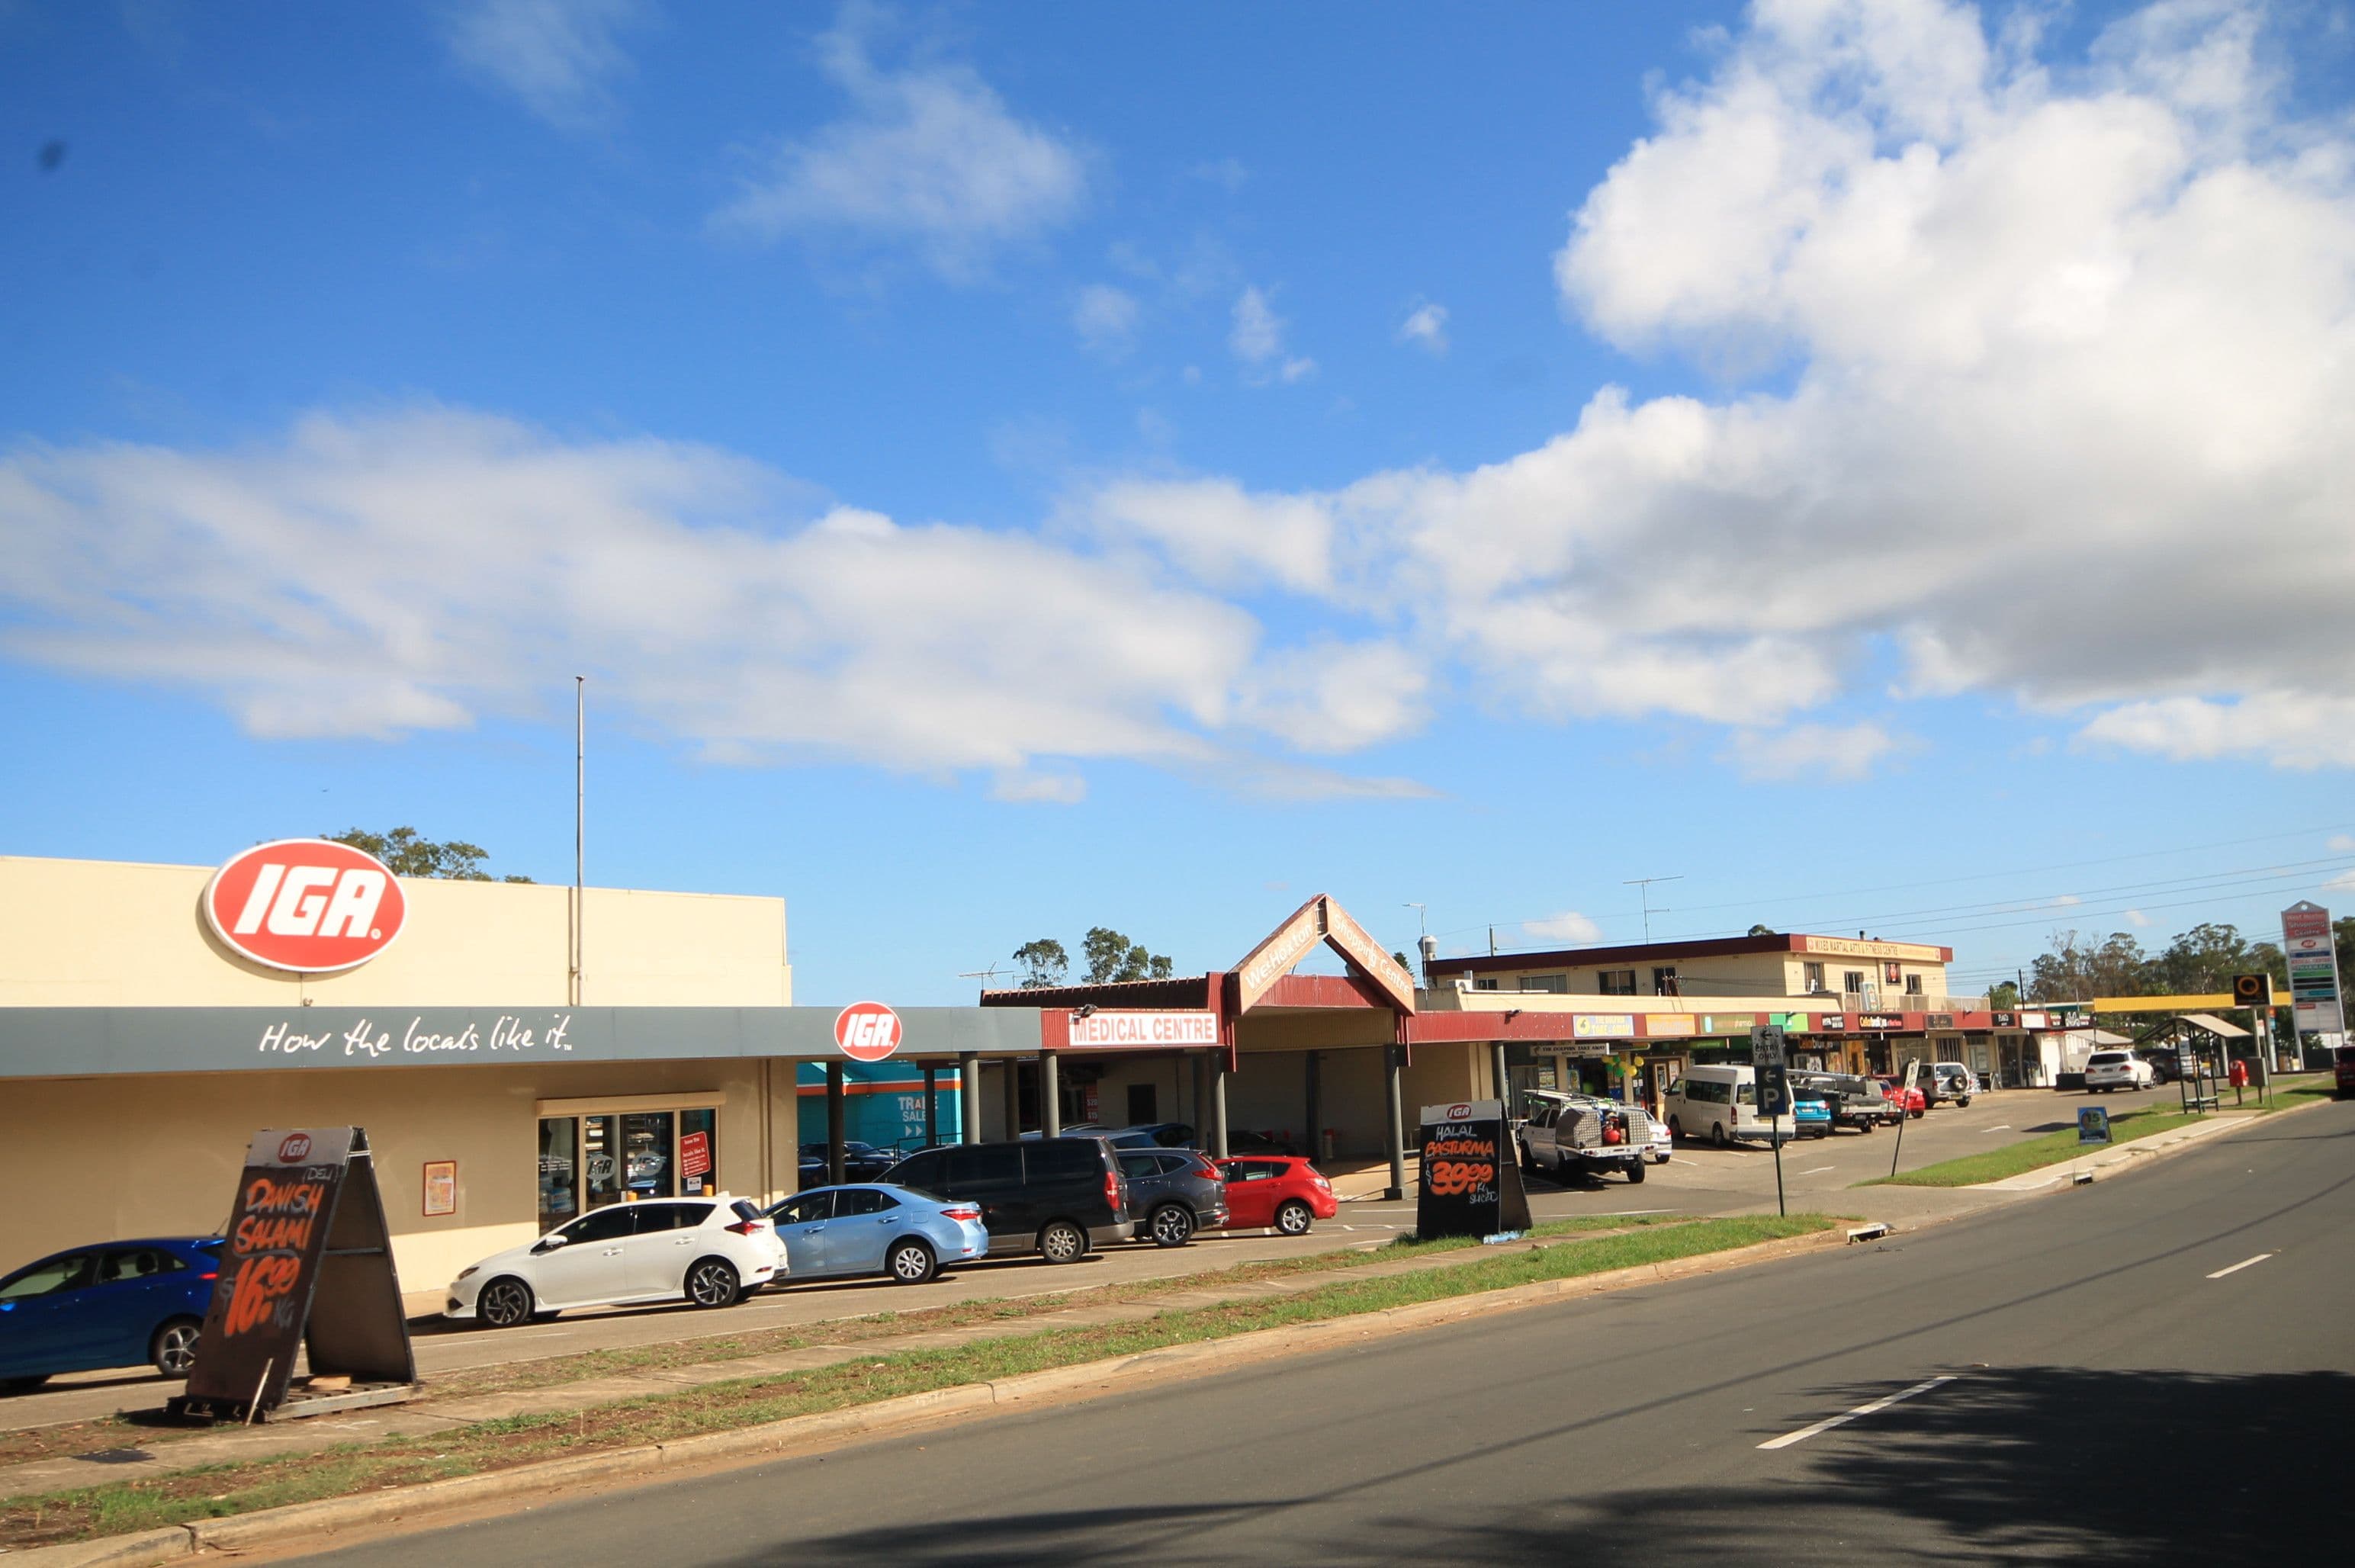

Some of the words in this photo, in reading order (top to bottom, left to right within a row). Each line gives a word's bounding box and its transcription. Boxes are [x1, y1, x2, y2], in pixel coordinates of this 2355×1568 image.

[1333, 914, 1377, 969] Shopping
[1380, 959, 1409, 996] Centre
[259, 1021, 331, 1053] How
[344, 1017, 391, 1057] the
[490, 1015, 534, 1050] like
[842, 1013, 895, 1047] IGA
[1074, 1018, 1148, 1042] MEDICAL
[1152, 1017, 1213, 1041] CENTRE
[1763, 1088, 1780, 1110] P
[902, 1111, 927, 1122] SALE
[1450, 1107, 1470, 1118] IGA
[1435, 1125, 1477, 1142] HALAL
[279, 1139, 309, 1158] IGA
[1425, 1141, 1496, 1158] BASTURMA
[245, 1178, 325, 1214] DANISH
[233, 1214, 313, 1255] SALAMI
